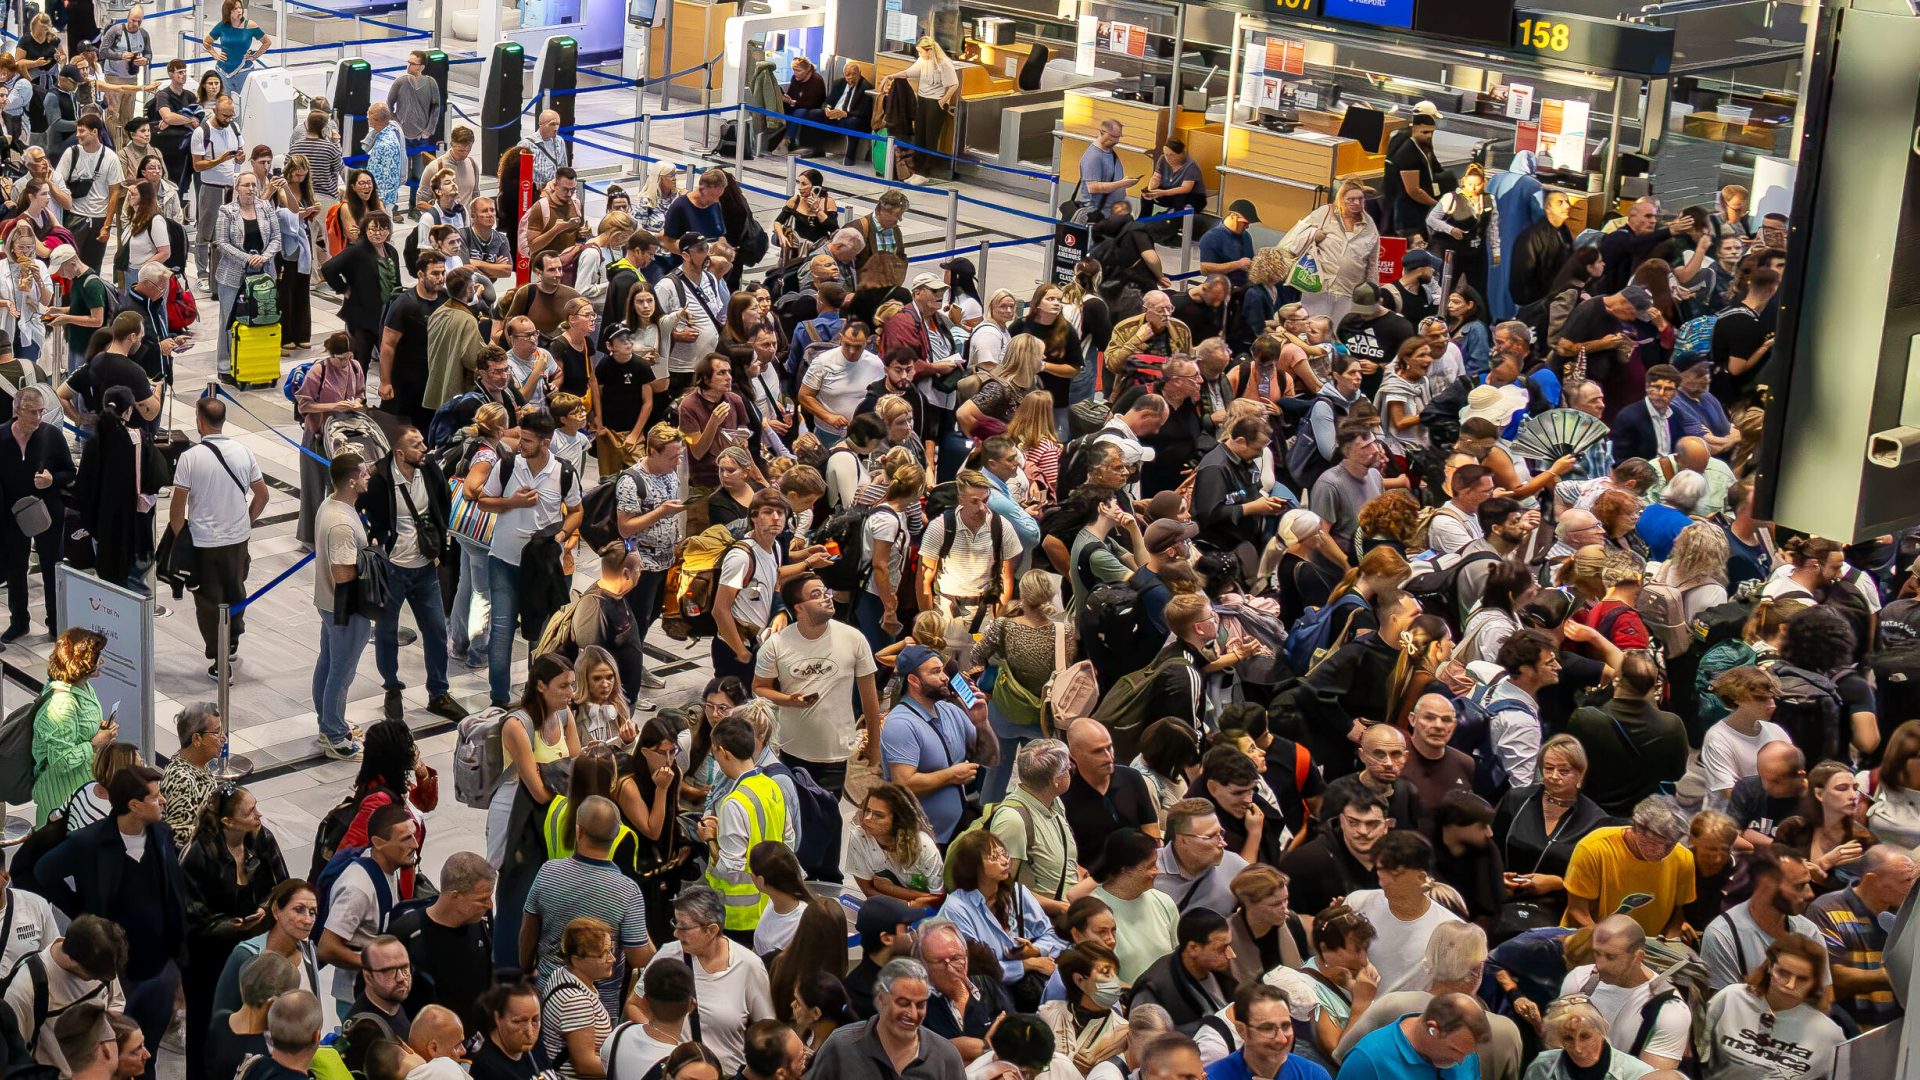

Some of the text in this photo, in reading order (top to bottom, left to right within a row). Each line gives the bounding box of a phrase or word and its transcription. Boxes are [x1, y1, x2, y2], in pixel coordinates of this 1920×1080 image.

[1519, 19, 1569, 52] 158
[805, 661, 822, 671] AIR
[801, 667, 825, 676] MAX
